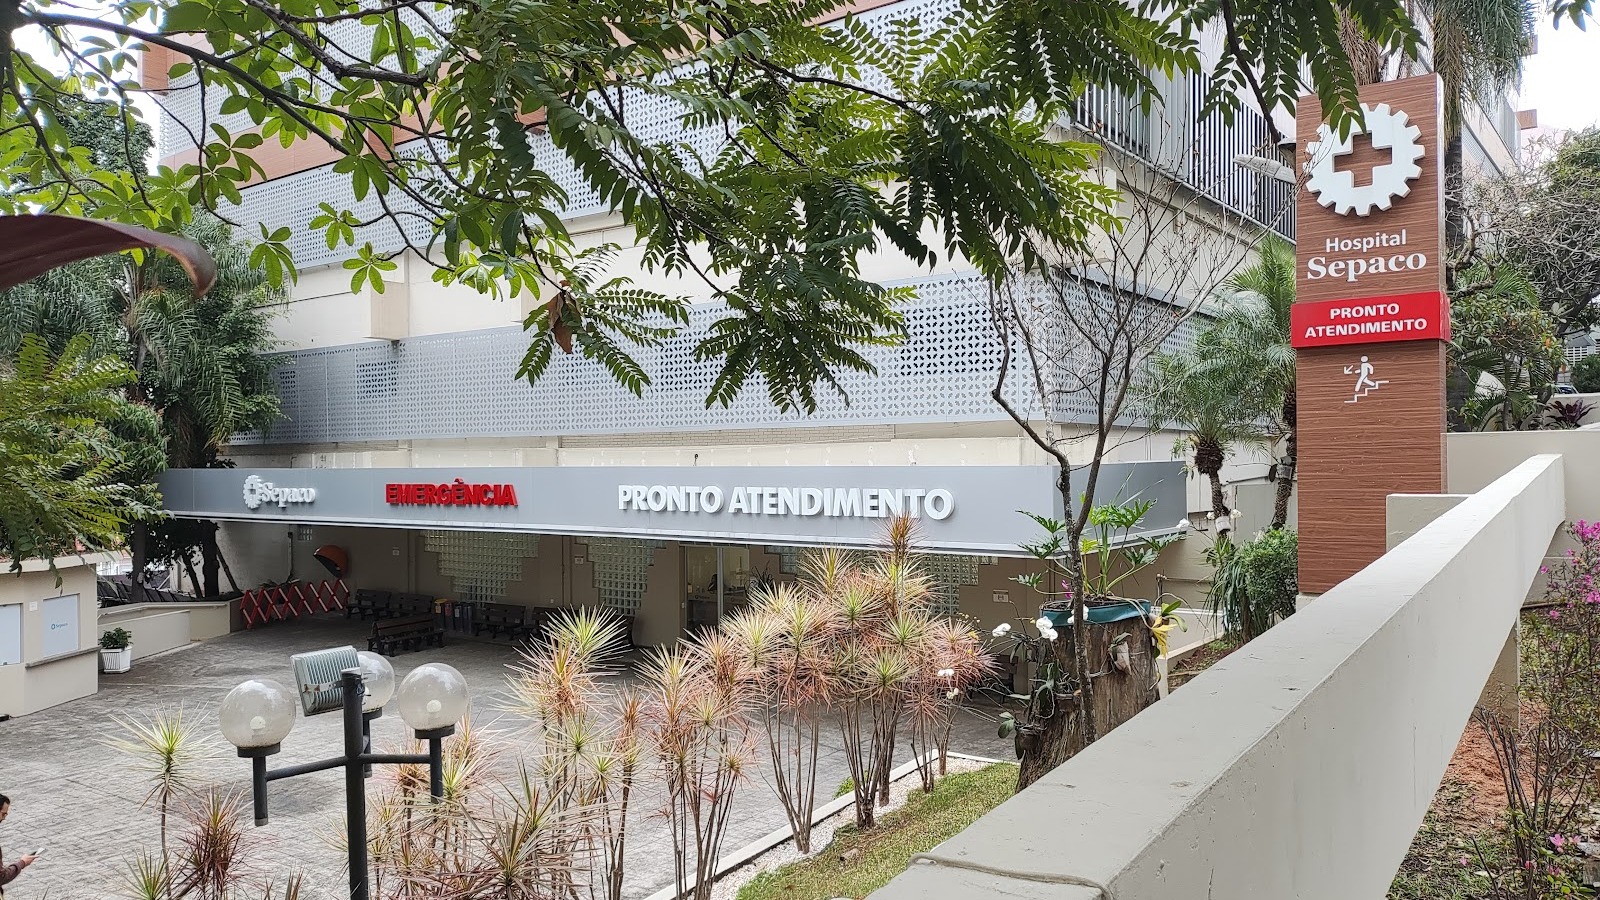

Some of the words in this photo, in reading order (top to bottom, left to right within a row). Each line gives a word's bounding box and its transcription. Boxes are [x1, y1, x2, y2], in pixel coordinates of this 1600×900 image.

[1325, 229, 1407, 253] Hospital
[1307, 252, 1427, 282] Sepaco
[1329, 303, 1400, 319] PRONTO
[1304, 318, 1428, 338] ATENDIMENTO
[261, 482, 316, 507] Sepaco
[385, 477, 519, 506] EMERGÊNCIA
[618, 485, 724, 513] PRONTO
[728, 486, 955, 520] ATENDIMENTO
